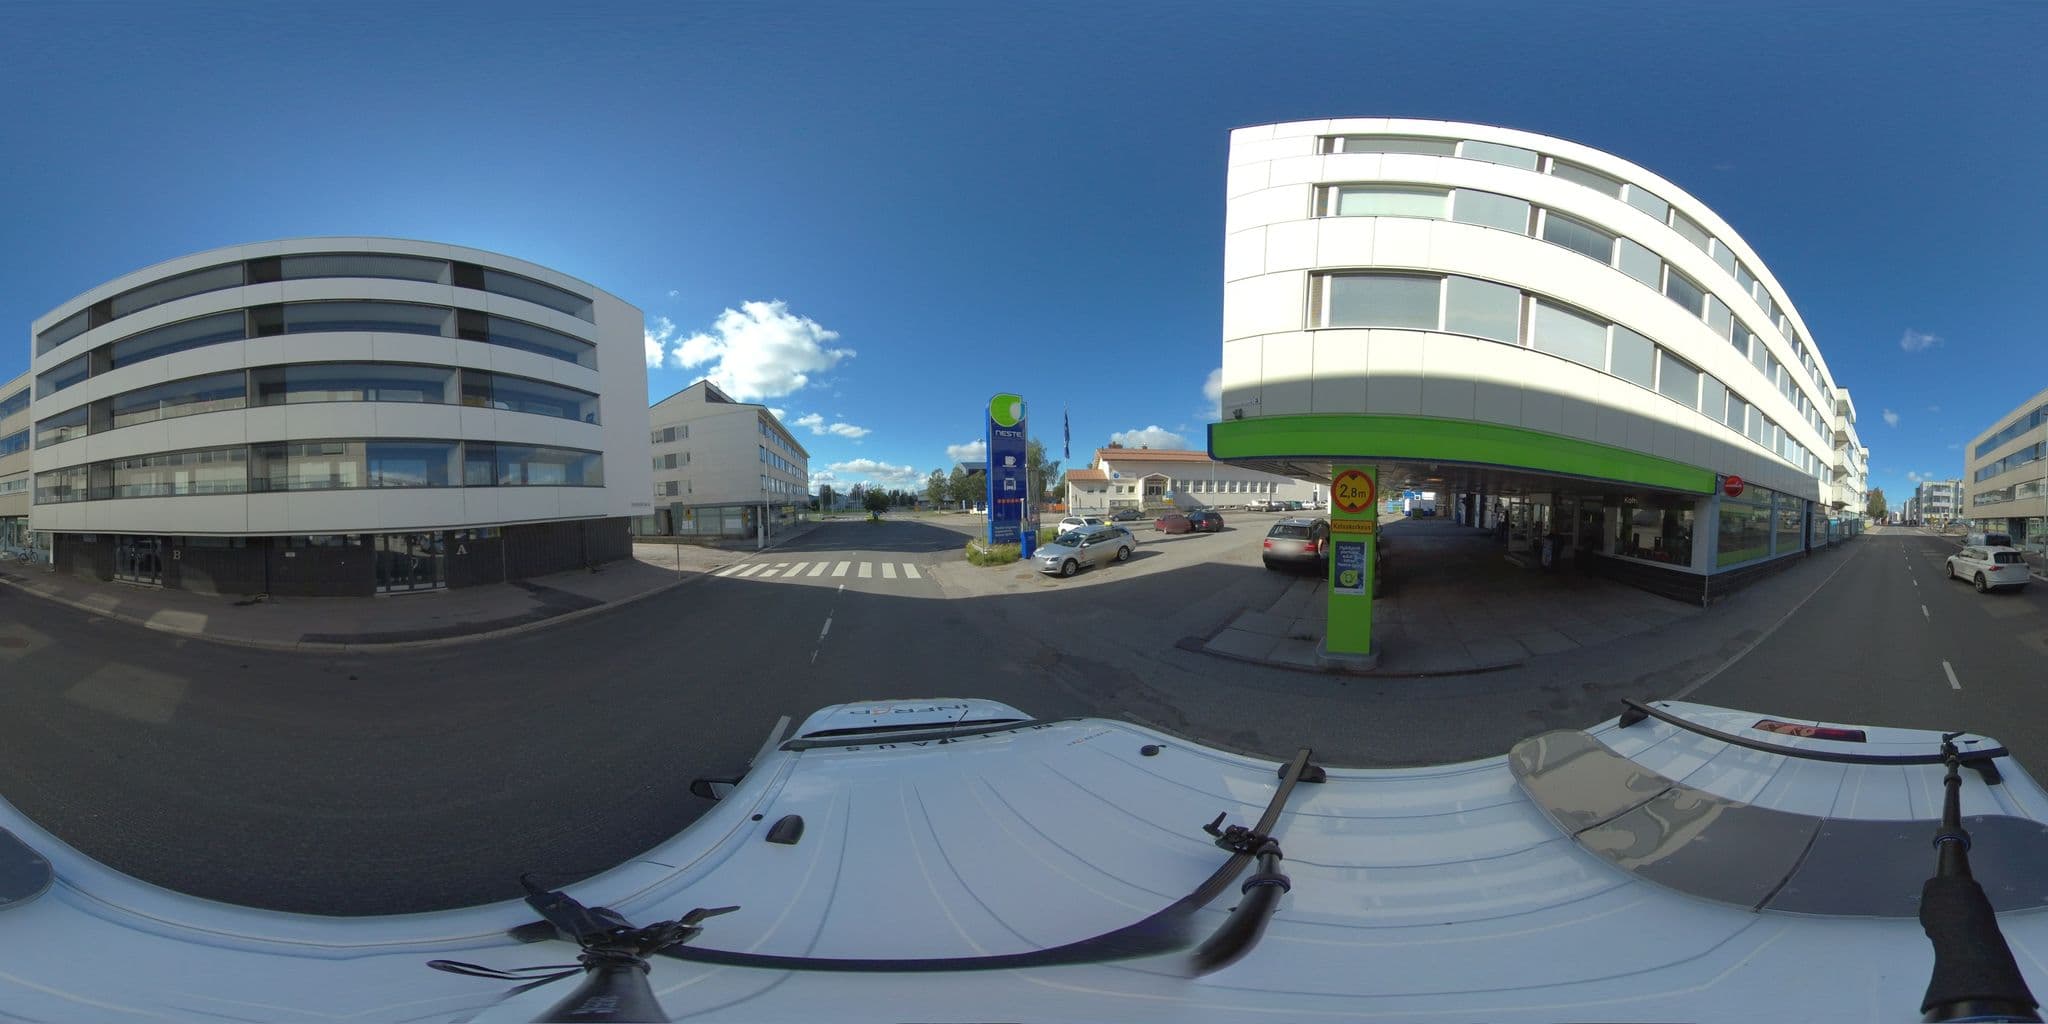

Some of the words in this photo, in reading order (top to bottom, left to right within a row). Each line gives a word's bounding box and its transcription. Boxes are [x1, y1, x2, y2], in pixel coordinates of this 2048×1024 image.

[995, 430, 1023, 438] NESTE
[173, 550, 181, 560] B
[456, 545, 468, 555] A
